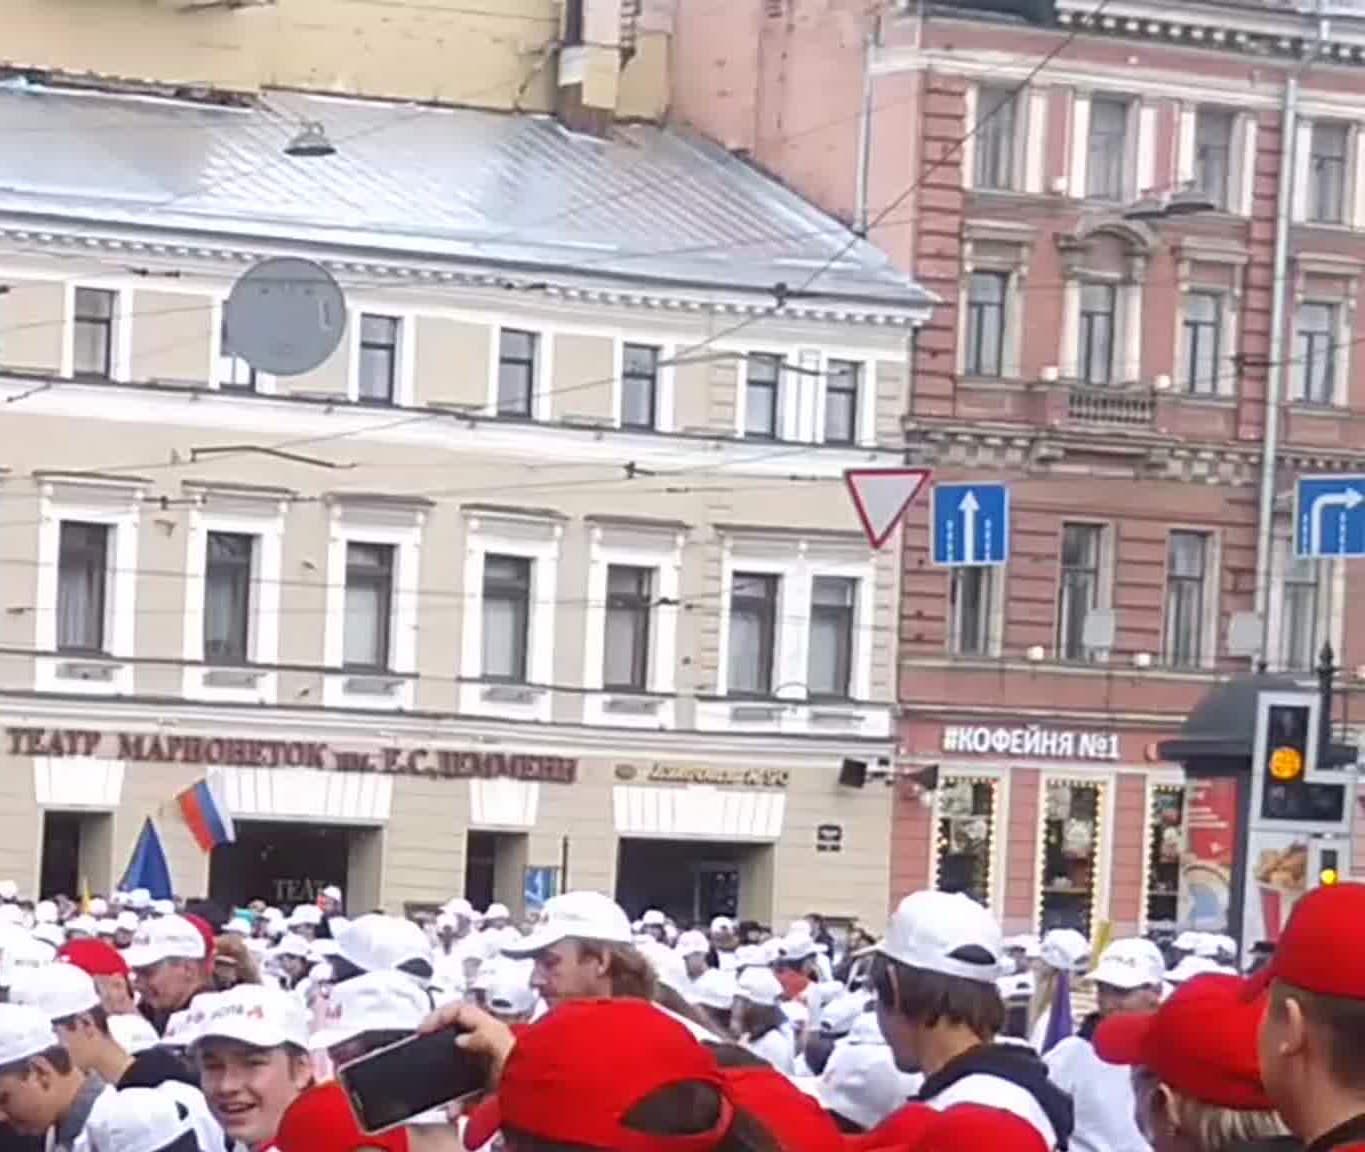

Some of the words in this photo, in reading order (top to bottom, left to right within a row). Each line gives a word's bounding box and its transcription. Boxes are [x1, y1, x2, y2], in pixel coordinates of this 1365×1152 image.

[6, 727, 101, 756] ТЕАТР
[944, 724, 1072, 757] #КОФЕЙНЯ
[1078, 733, 1120, 758] №1
